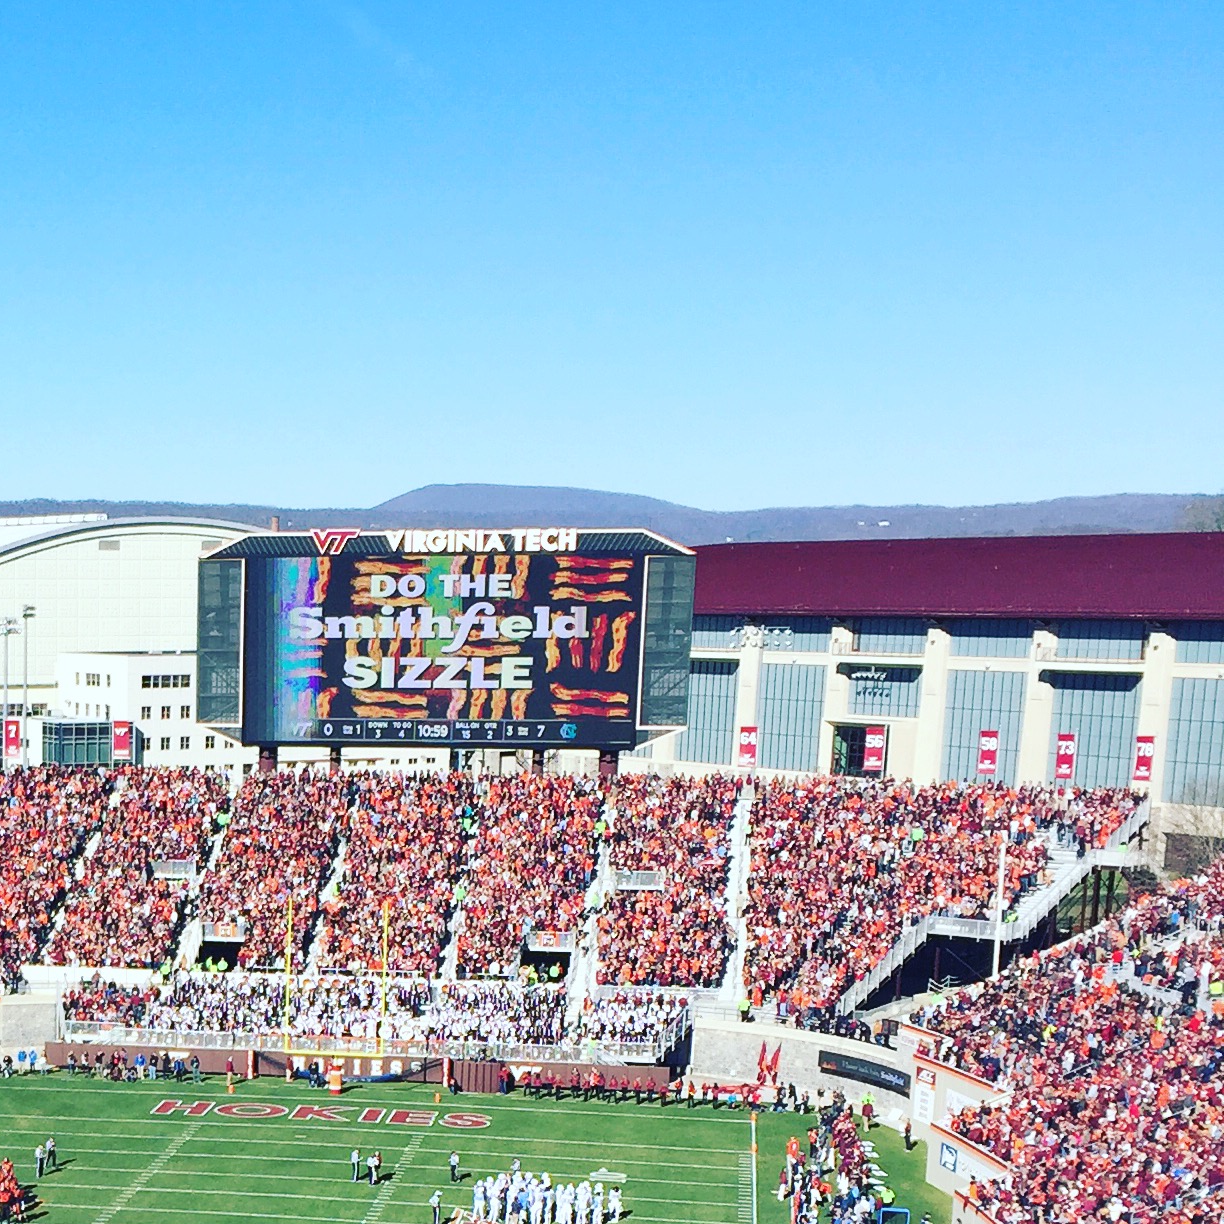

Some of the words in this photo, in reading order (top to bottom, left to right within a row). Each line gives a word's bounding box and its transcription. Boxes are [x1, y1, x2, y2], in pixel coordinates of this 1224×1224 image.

[310, 528, 361, 555] VT
[384, 529, 505, 552] VIRGINIA
[510, 529, 577, 552] TECH
[370, 574, 425, 598] DO
[438, 574, 512, 598] THE
[288, 602, 589, 653] Smithfield
[342, 656, 533, 689] SIZZLE
[8, 725, 16, 738] 7
[115, 727, 129, 737] VT
[324, 723, 333, 736] 0
[356, 725, 361, 735] 1
[375, 730, 381, 739] 3
[399, 730, 405, 738] 4
[417, 725, 448, 738] 10:59
[462, 731, 470, 739] 15
[487, 731, 493, 739] 2
[507, 726, 513, 736] 3
[537, 725, 545, 738] 7
[740, 732, 757, 745] 64
[865, 735, 884, 748] 56
[1058, 741, 1075, 755] 73
[1137, 743, 1154, 757] 78
[150, 1099, 492, 1129] HOKIES
